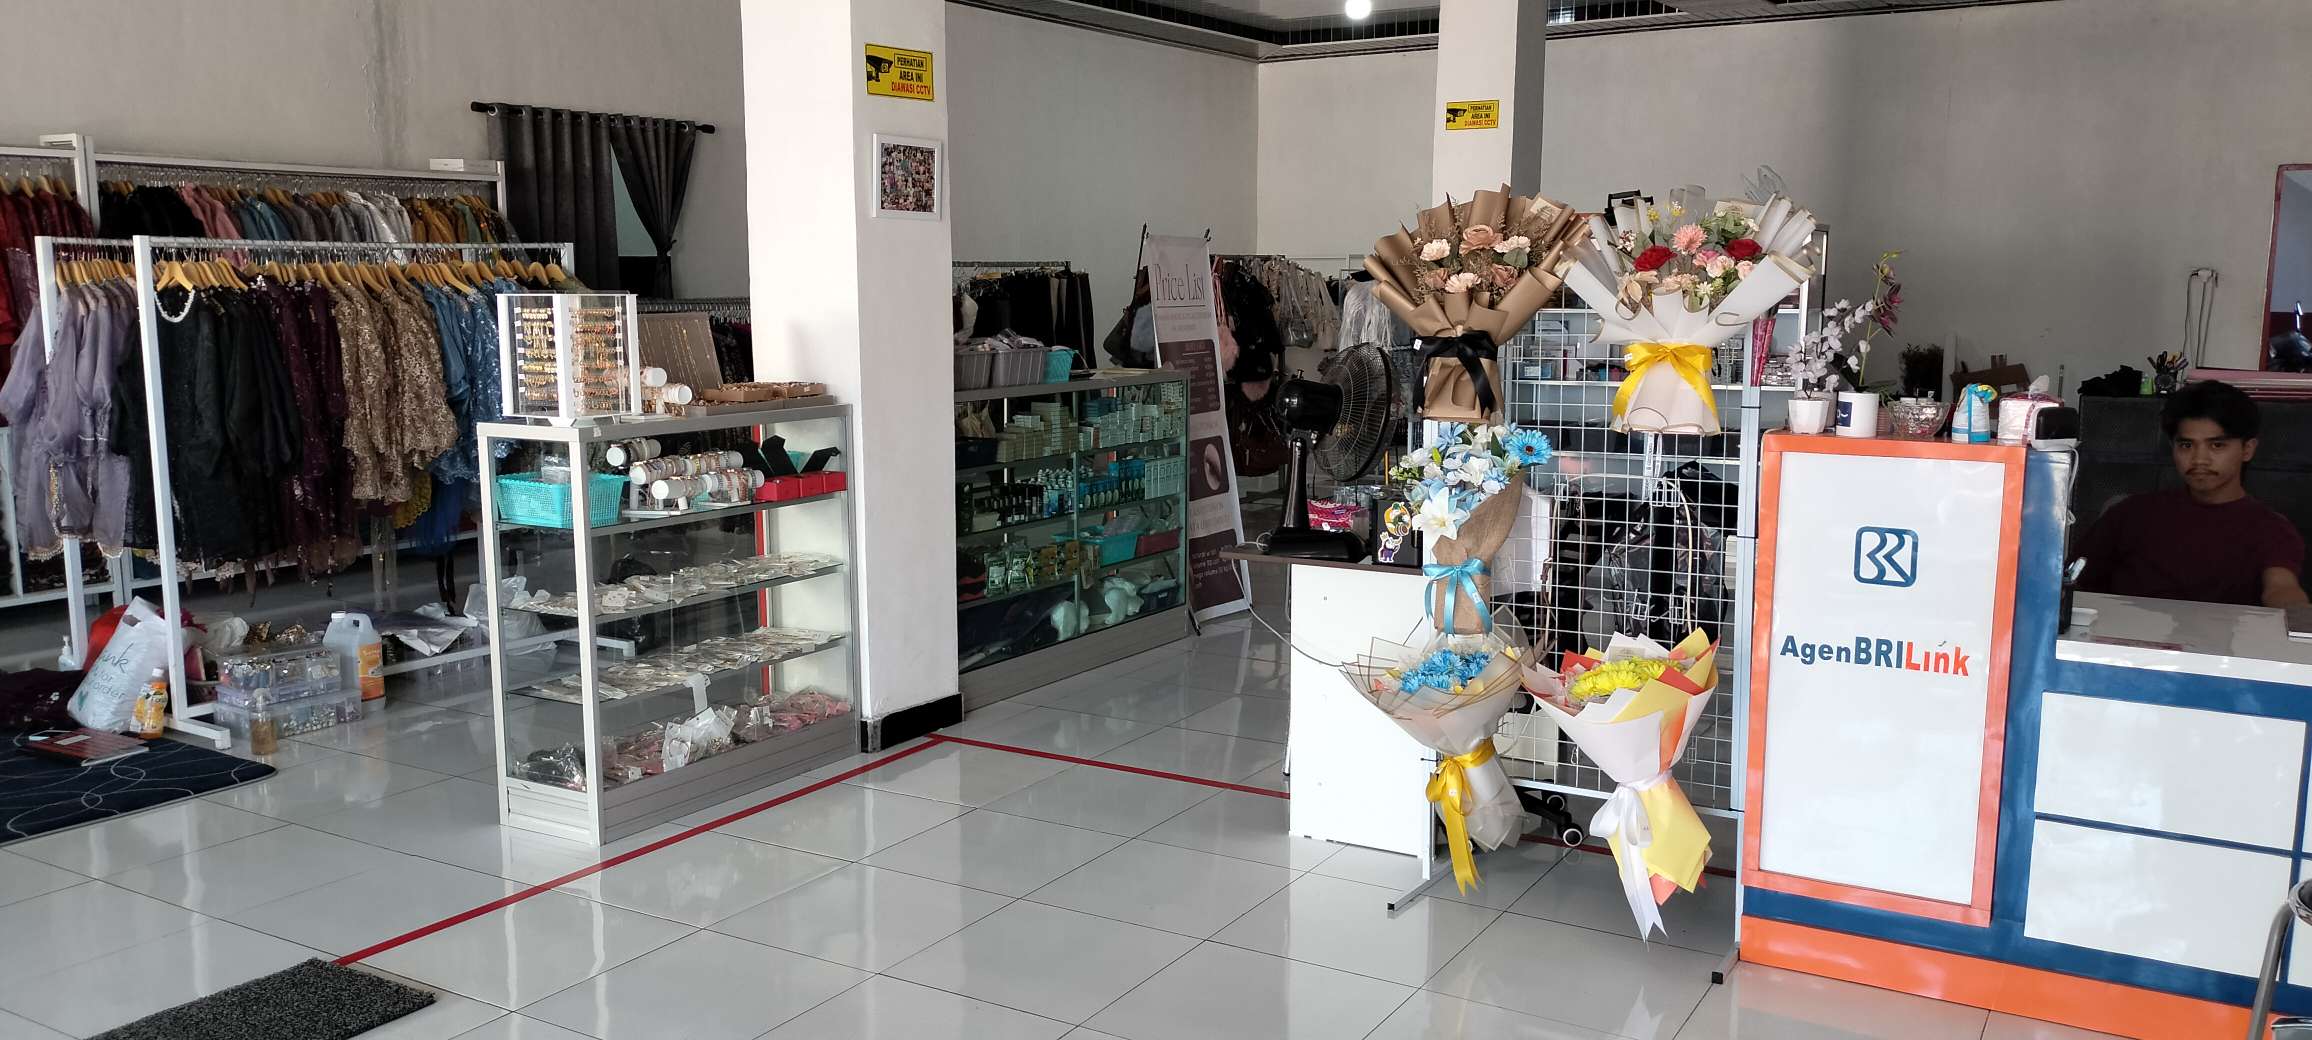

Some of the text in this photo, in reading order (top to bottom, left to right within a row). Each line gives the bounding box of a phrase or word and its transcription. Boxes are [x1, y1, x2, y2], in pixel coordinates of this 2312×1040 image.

[896, 56, 925, 69] PERHATIAN
[899, 70, 924, 83] AREA INI
[891, 81, 931, 96] DIAWASI CCTV
[1154, 263, 1205, 301] Price List
[1779, 634, 1971, 677] AgenBRILink
